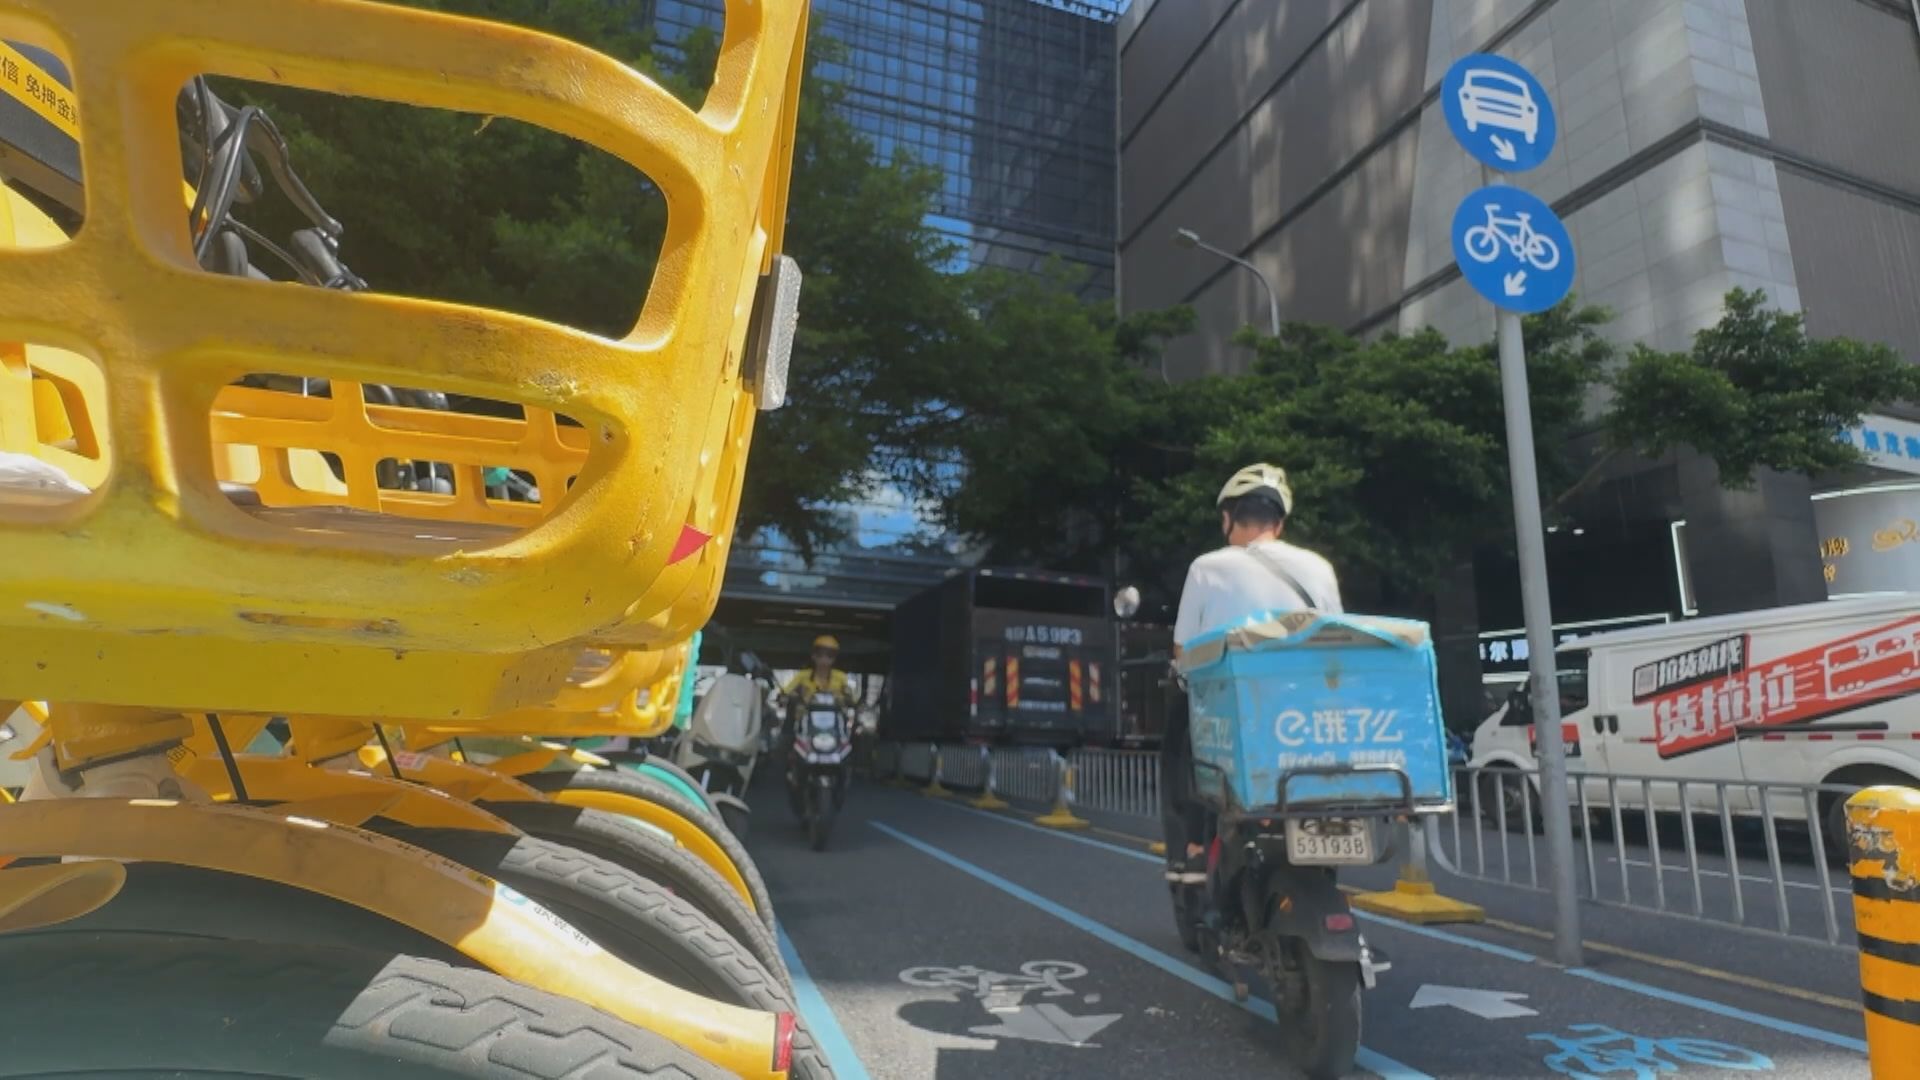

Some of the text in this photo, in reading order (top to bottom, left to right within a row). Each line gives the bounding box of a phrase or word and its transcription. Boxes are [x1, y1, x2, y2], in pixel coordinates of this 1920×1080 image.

[0, 56, 19, 85] 信
[1657, 663, 1797, 746] 货拉拉
